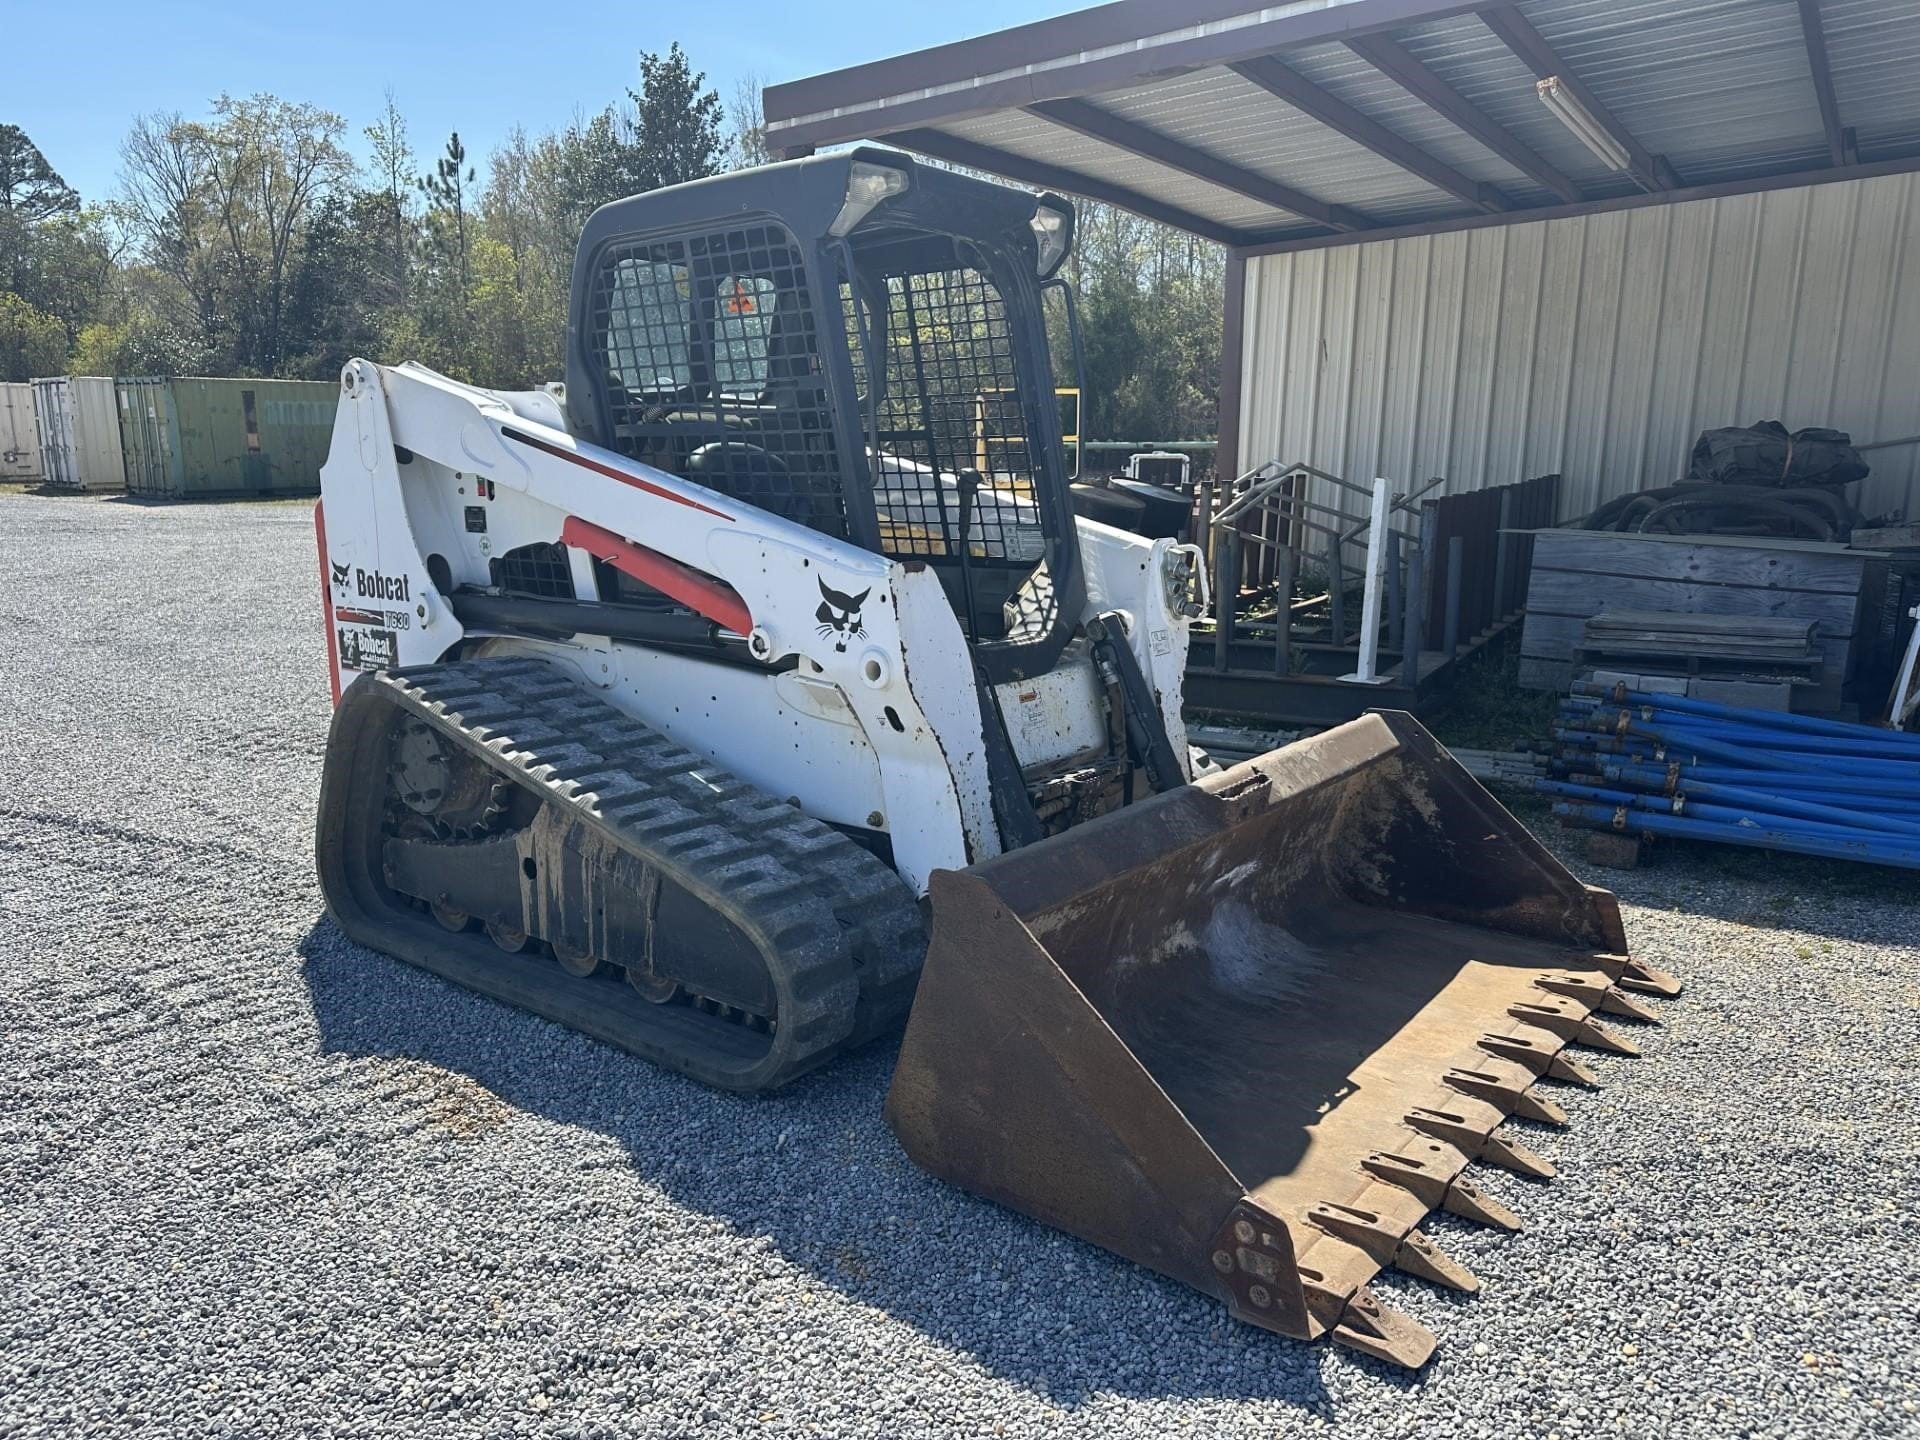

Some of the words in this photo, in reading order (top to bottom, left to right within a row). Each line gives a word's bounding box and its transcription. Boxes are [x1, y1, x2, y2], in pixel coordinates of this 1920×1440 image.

[356, 568, 410, 602] Bobcat
[385, 610, 410, 630] T630
[358, 633, 390, 655] Bobcat
